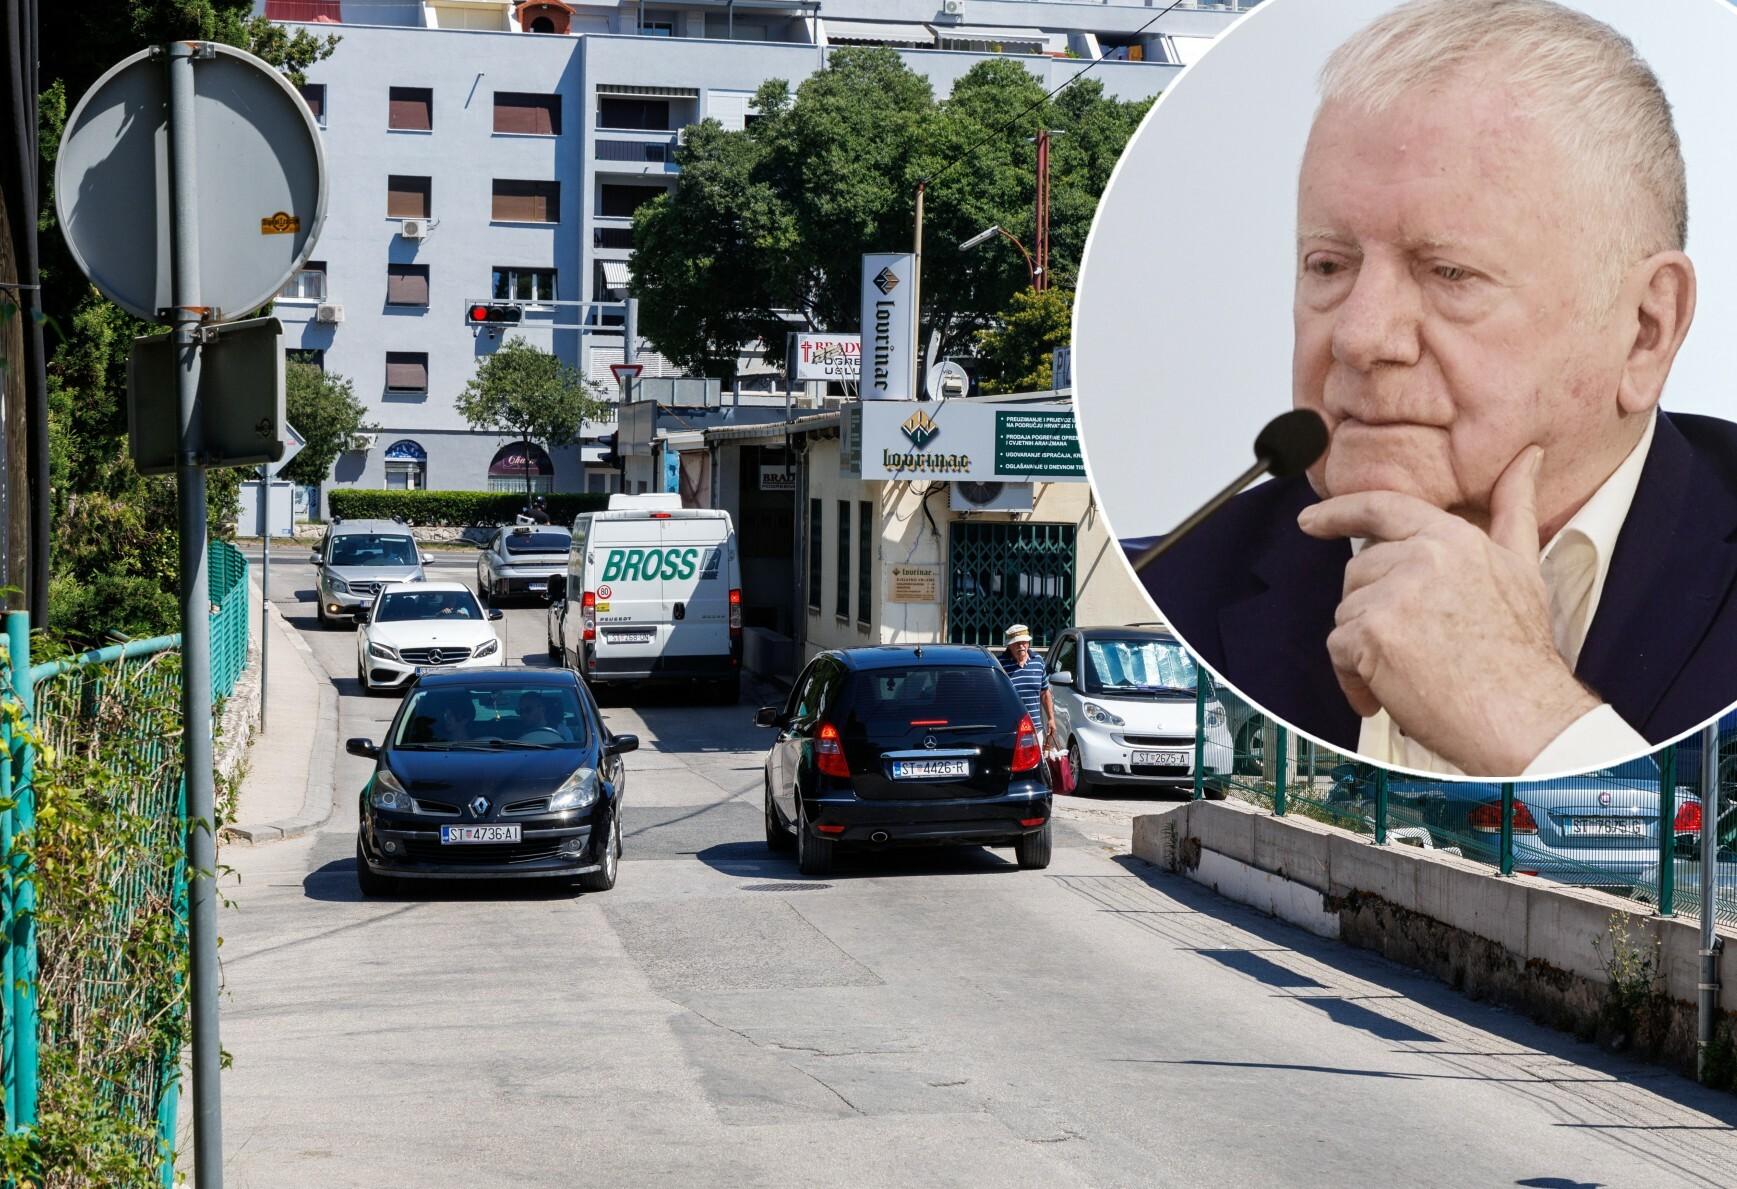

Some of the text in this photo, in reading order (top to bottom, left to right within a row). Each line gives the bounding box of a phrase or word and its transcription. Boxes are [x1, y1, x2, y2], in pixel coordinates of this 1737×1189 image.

[602, 548, 698, 582] BROSS
[600, 587, 609, 596] 80
[902, 762, 916, 775] ST
[450, 828, 464, 841] ST
